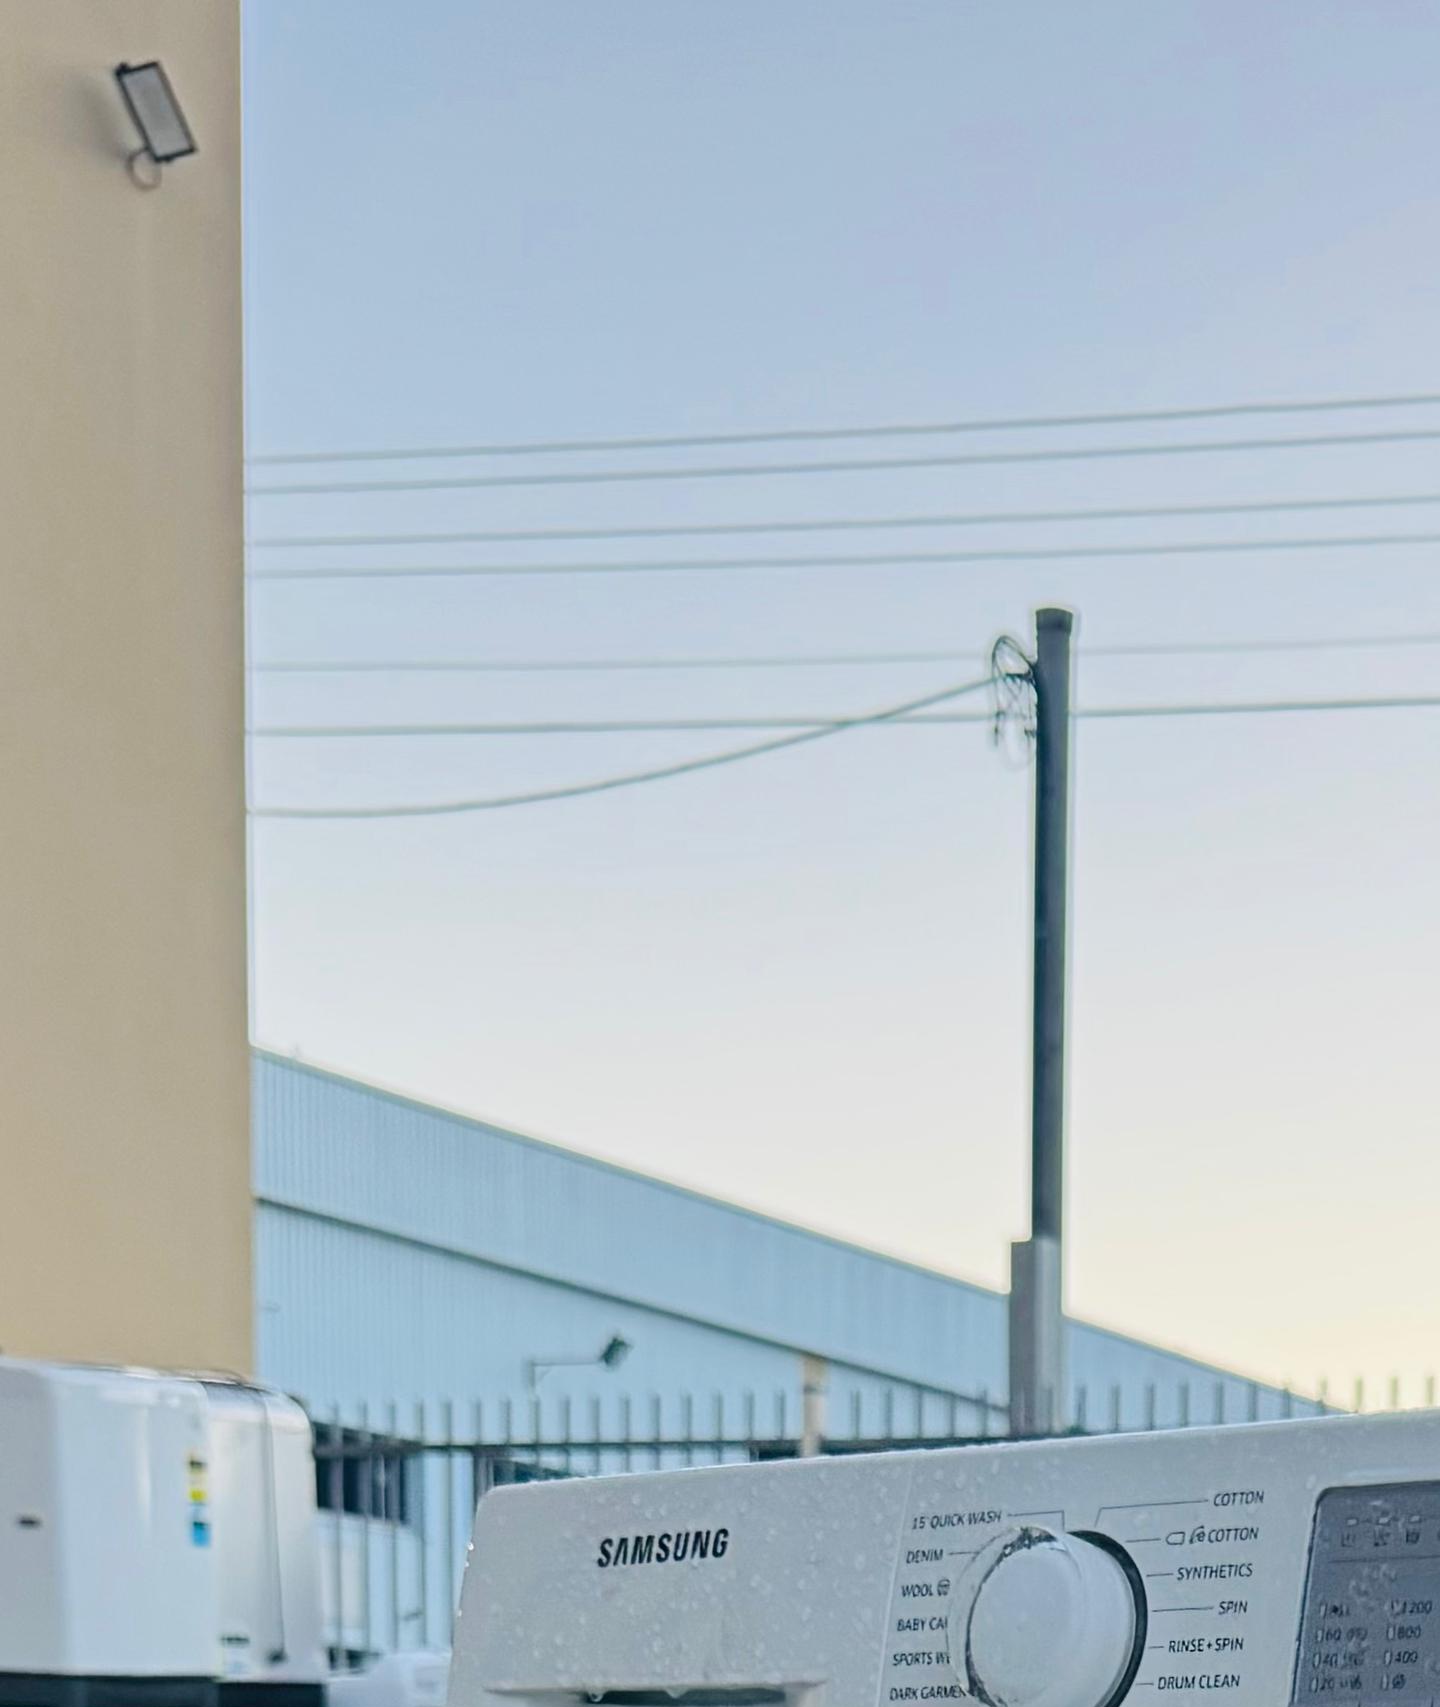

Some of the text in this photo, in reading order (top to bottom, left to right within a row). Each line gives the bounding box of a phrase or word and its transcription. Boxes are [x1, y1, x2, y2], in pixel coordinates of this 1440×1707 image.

[1213, 1490, 1265, 1507] COTTON
[930, 1513, 965, 1530] QUICK
[967, 1510, 1002, 1526] WASH
[1208, 1527, 1259, 1543] COTTON
[597, 1528, 729, 1568] SAMSUNG
[906, 1549, 944, 1564] DENIM
[1177, 1562, 1253, 1581] SYNTHETICS
[901, 1583, 934, 1598] WOOL
[1218, 1600, 1248, 1616] SPIN
[896, 1618, 926, 1632] BABY
[892, 1651, 933, 1666] SPORTS
[1157, 1673, 1241, 1691] DRUM CLEAN
